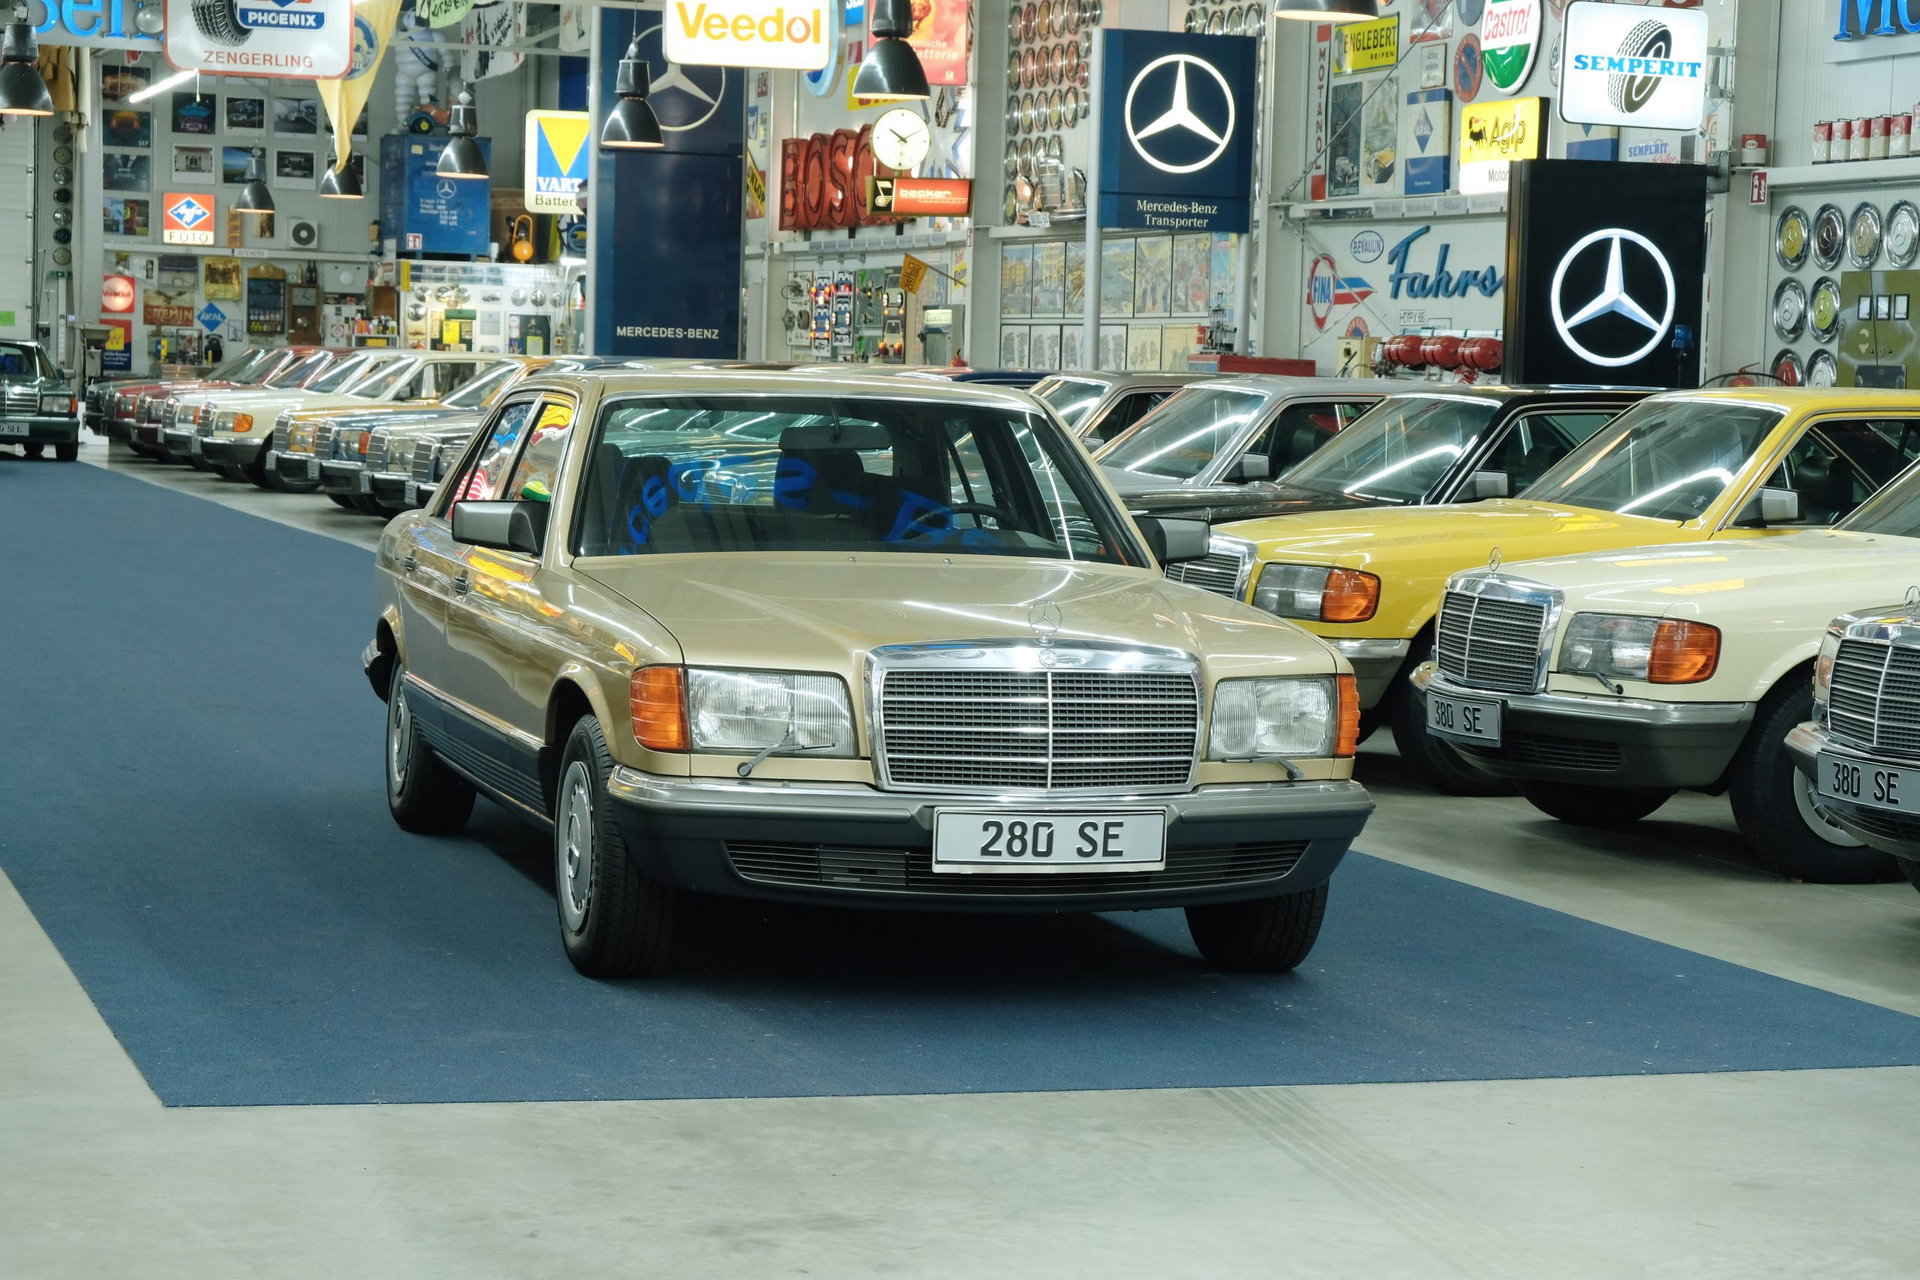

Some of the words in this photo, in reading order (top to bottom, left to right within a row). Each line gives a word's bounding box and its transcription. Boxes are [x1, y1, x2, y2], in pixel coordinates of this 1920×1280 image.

[247, 11, 317, 27] PHOENIX
[675, 2, 823, 44] Veedol
[1484, 4, 1532, 41] Castrol
[1344, 26, 1397, 54] ENGLEBERT
[203, 51, 314, 68] ZENGERLING
[1574, 54, 1701, 77] SEMPERIT
[1314, 48, 1327, 170] MOTANOL
[1489, 113, 1527, 154] Agip
[1628, 142, 1669, 157] SEMPERIT
[536, 176, 583, 192] VART
[780, 125, 913, 231] BOSC
[535, 194, 575, 207] Batter
[1136, 199, 1218, 215] Mercedes-Benz
[1145, 214, 1209, 228] Transporter
[168, 231, 209, 243] FOTO
[1387, 225, 1506, 300] Fahrs
[1313, 275, 1331, 304] FINA
[200, 312, 222, 321] ARAL
[616, 325, 719, 339] MERCEDES-BENZ
[1434, 700, 1454, 728] 380
[1463, 705, 1483, 735] SE
[1832, 762, 1861, 797] 380
[1873, 770, 1900, 805] SE
[980, 820, 1054, 858] 280
[1075, 820, 1124, 858] SE
